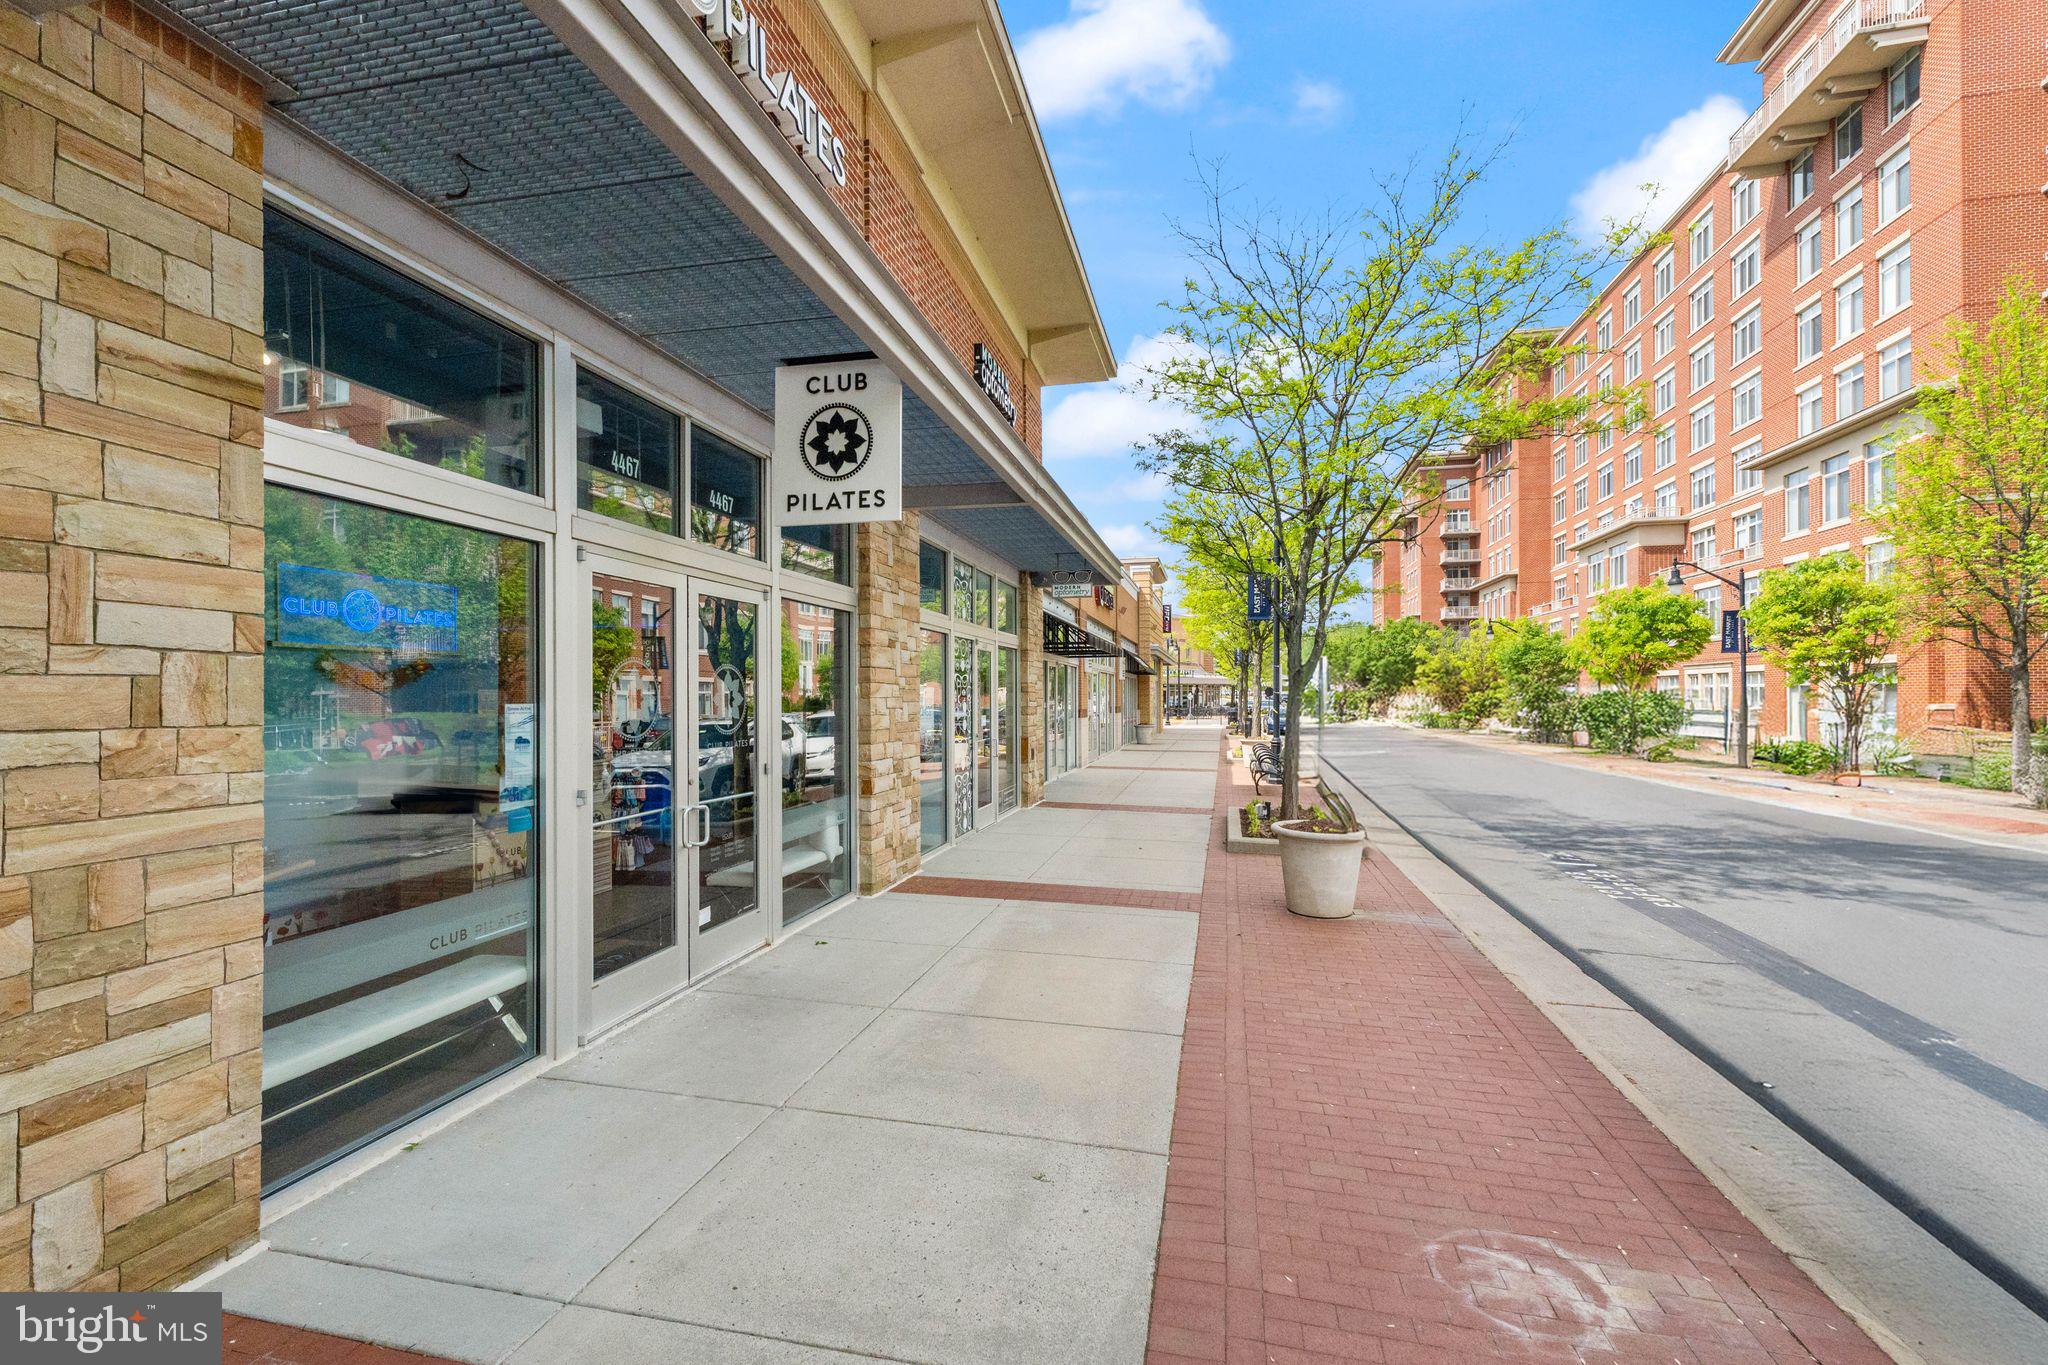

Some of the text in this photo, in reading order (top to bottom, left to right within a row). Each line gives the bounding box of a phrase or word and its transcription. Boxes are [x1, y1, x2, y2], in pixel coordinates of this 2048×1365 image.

[723, 0, 846, 187] PILATES
[806, 372, 868, 395] CLUB
[611, 450, 640, 479] 4467
[709, 489, 734, 514] 4467
[786, 489, 886, 512] PILATES
[1054, 589, 1090, 598] optometry
[1253, 594, 1261, 614] EAST
[282, 597, 454, 628] CLUB PILATES
[429, 928, 468, 951] CLUB
